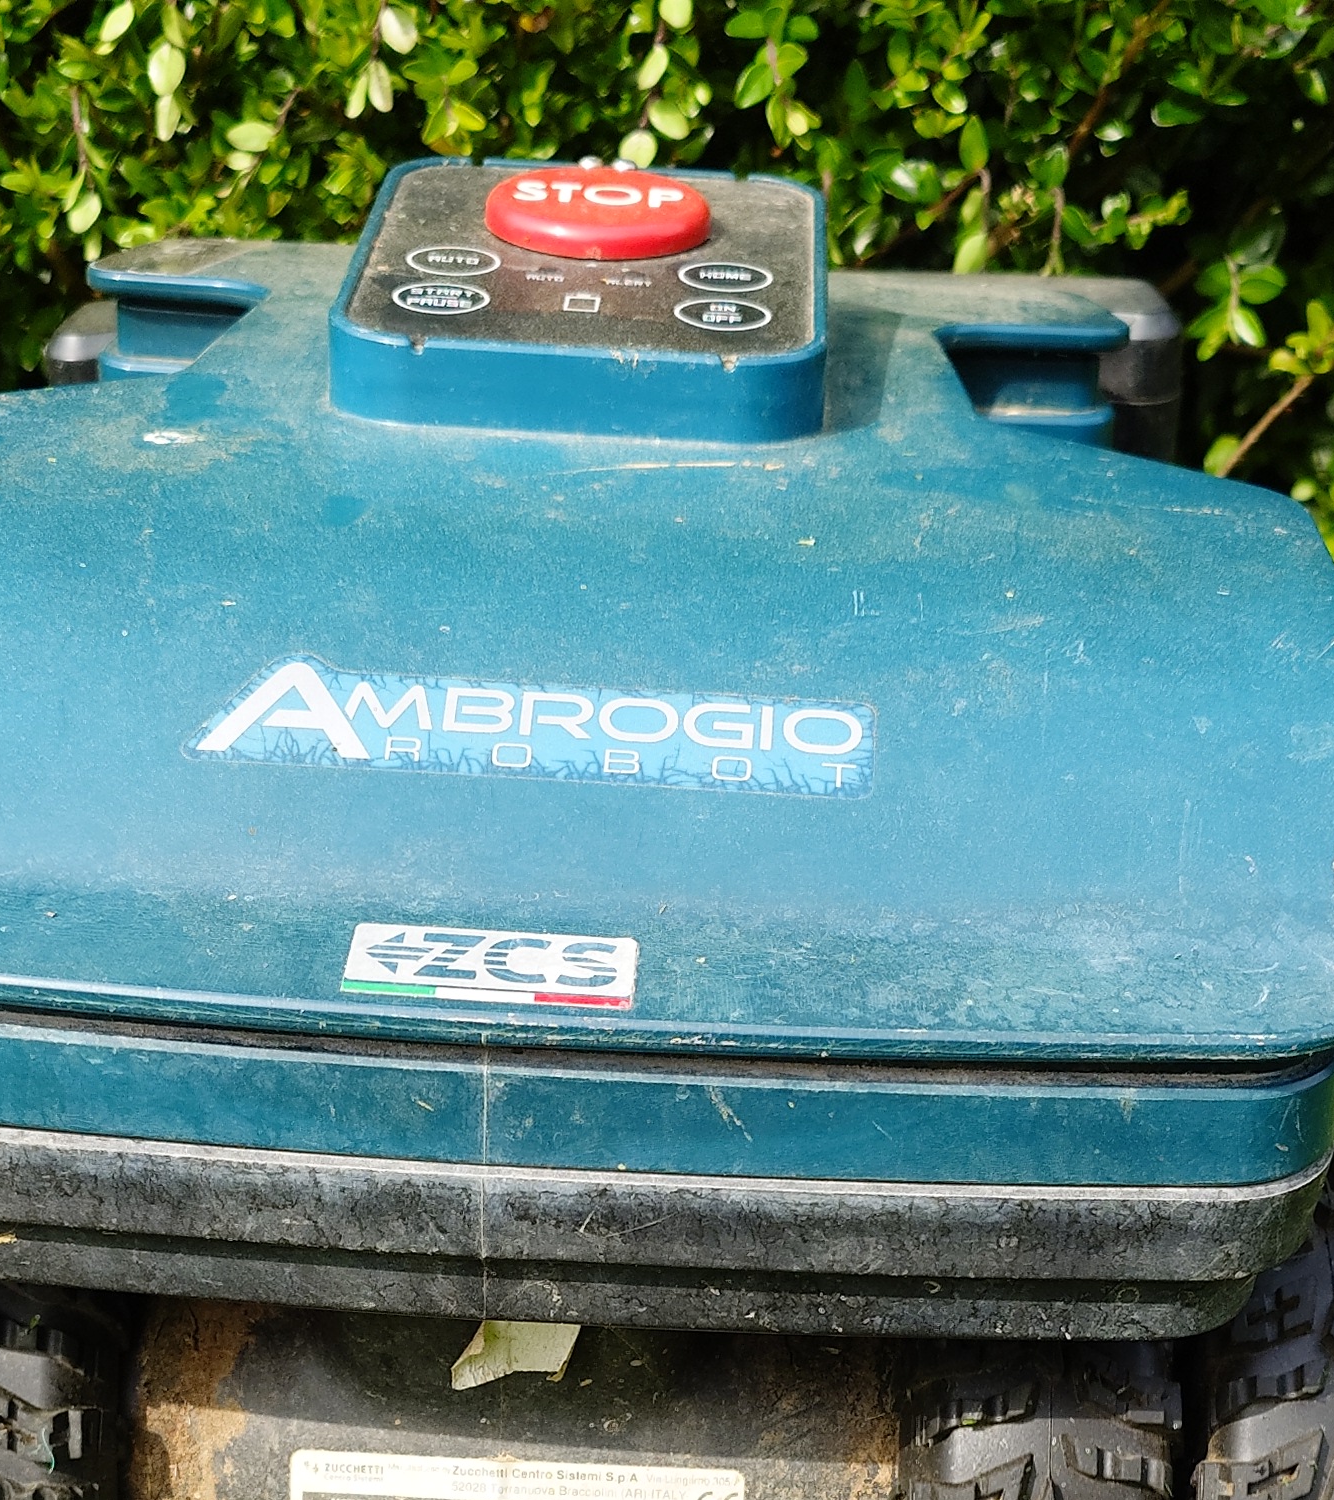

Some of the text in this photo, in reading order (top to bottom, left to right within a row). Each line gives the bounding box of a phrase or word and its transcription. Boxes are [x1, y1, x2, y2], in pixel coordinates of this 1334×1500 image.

[512, 179, 684, 208] STOP
[427, 252, 480, 266] AUTO
[524, 272, 565, 283] AUTO
[699, 270, 753, 282] HOME
[409, 287, 475, 297] START
[406, 296, 473, 309] PAUSE
[709, 303, 737, 313] ON
[702, 313, 743, 324] OFF
[384, 736, 859, 789] ROBOT
[413, 933, 620, 988] ZCS
[324, 1463, 384, 1475] ZUCCHETTI
[452, 1465, 508, 1479] Zucchetti
[512, 1468, 553, 1479] Centro
[556, 1470, 602, 1482] Sistemi
